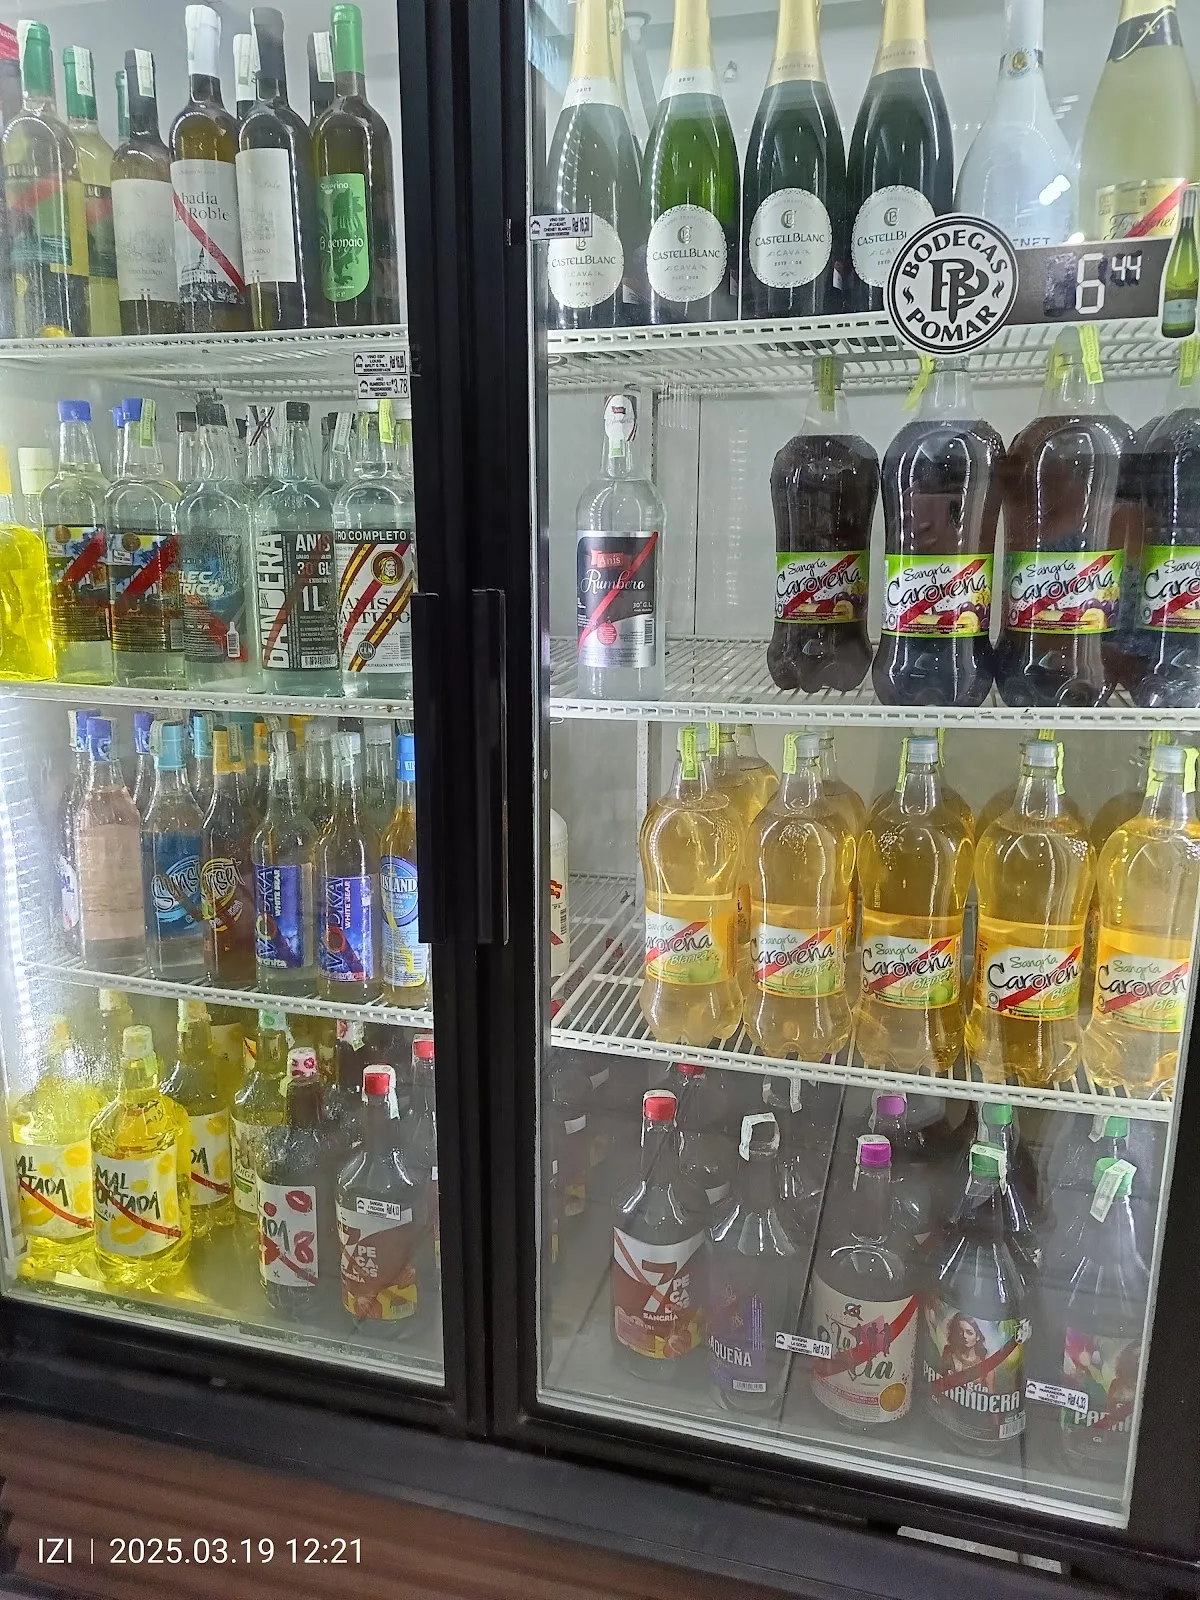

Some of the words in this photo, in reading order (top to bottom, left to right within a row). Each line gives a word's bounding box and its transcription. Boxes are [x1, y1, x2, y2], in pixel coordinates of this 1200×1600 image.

[189, 207, 230, 221] Roble
[902, 229, 1010, 280] BODEGAS
[1075, 253, 1105, 314] 6
[905, 305, 998, 342] POMAR
[295, 534, 331, 551] ANIS
[348, 531, 407, 540] COMPLETO
[788, 558, 828, 576] Sangría
[904, 563, 952, 584] Sangría
[1026, 560, 1076, 580] Sangría
[581, 568, 646, 594] Rumbero
[776, 562, 862, 598] Caroreña
[887, 569, 987, 607] Caroreña
[1010, 566, 1116, 602] Caroreña
[273, 870, 281, 890] BEAR
[380, 874, 418, 893] ISLAND
[323, 879, 344, 969] VODKA
[750, 938, 834, 964] Caroreña
[759, 933, 798, 951] Sangría
[875, 943, 918, 961] Sangría
[670, 950, 709, 965] Blanca
[862, 947, 954, 978] Caroreña
[1010, 954, 1058, 974] Sangría
[793, 961, 835, 979] Blanca
[912, 970, 953, 990] Blanca
[1113, 960, 1161, 980] Sangría
[358, 1245, 376, 1258] PE
[672, 1273, 690, 1291] PE
[670, 1288, 690, 1303] CA
[642, 1312, 679, 1322] SANGRÍA
